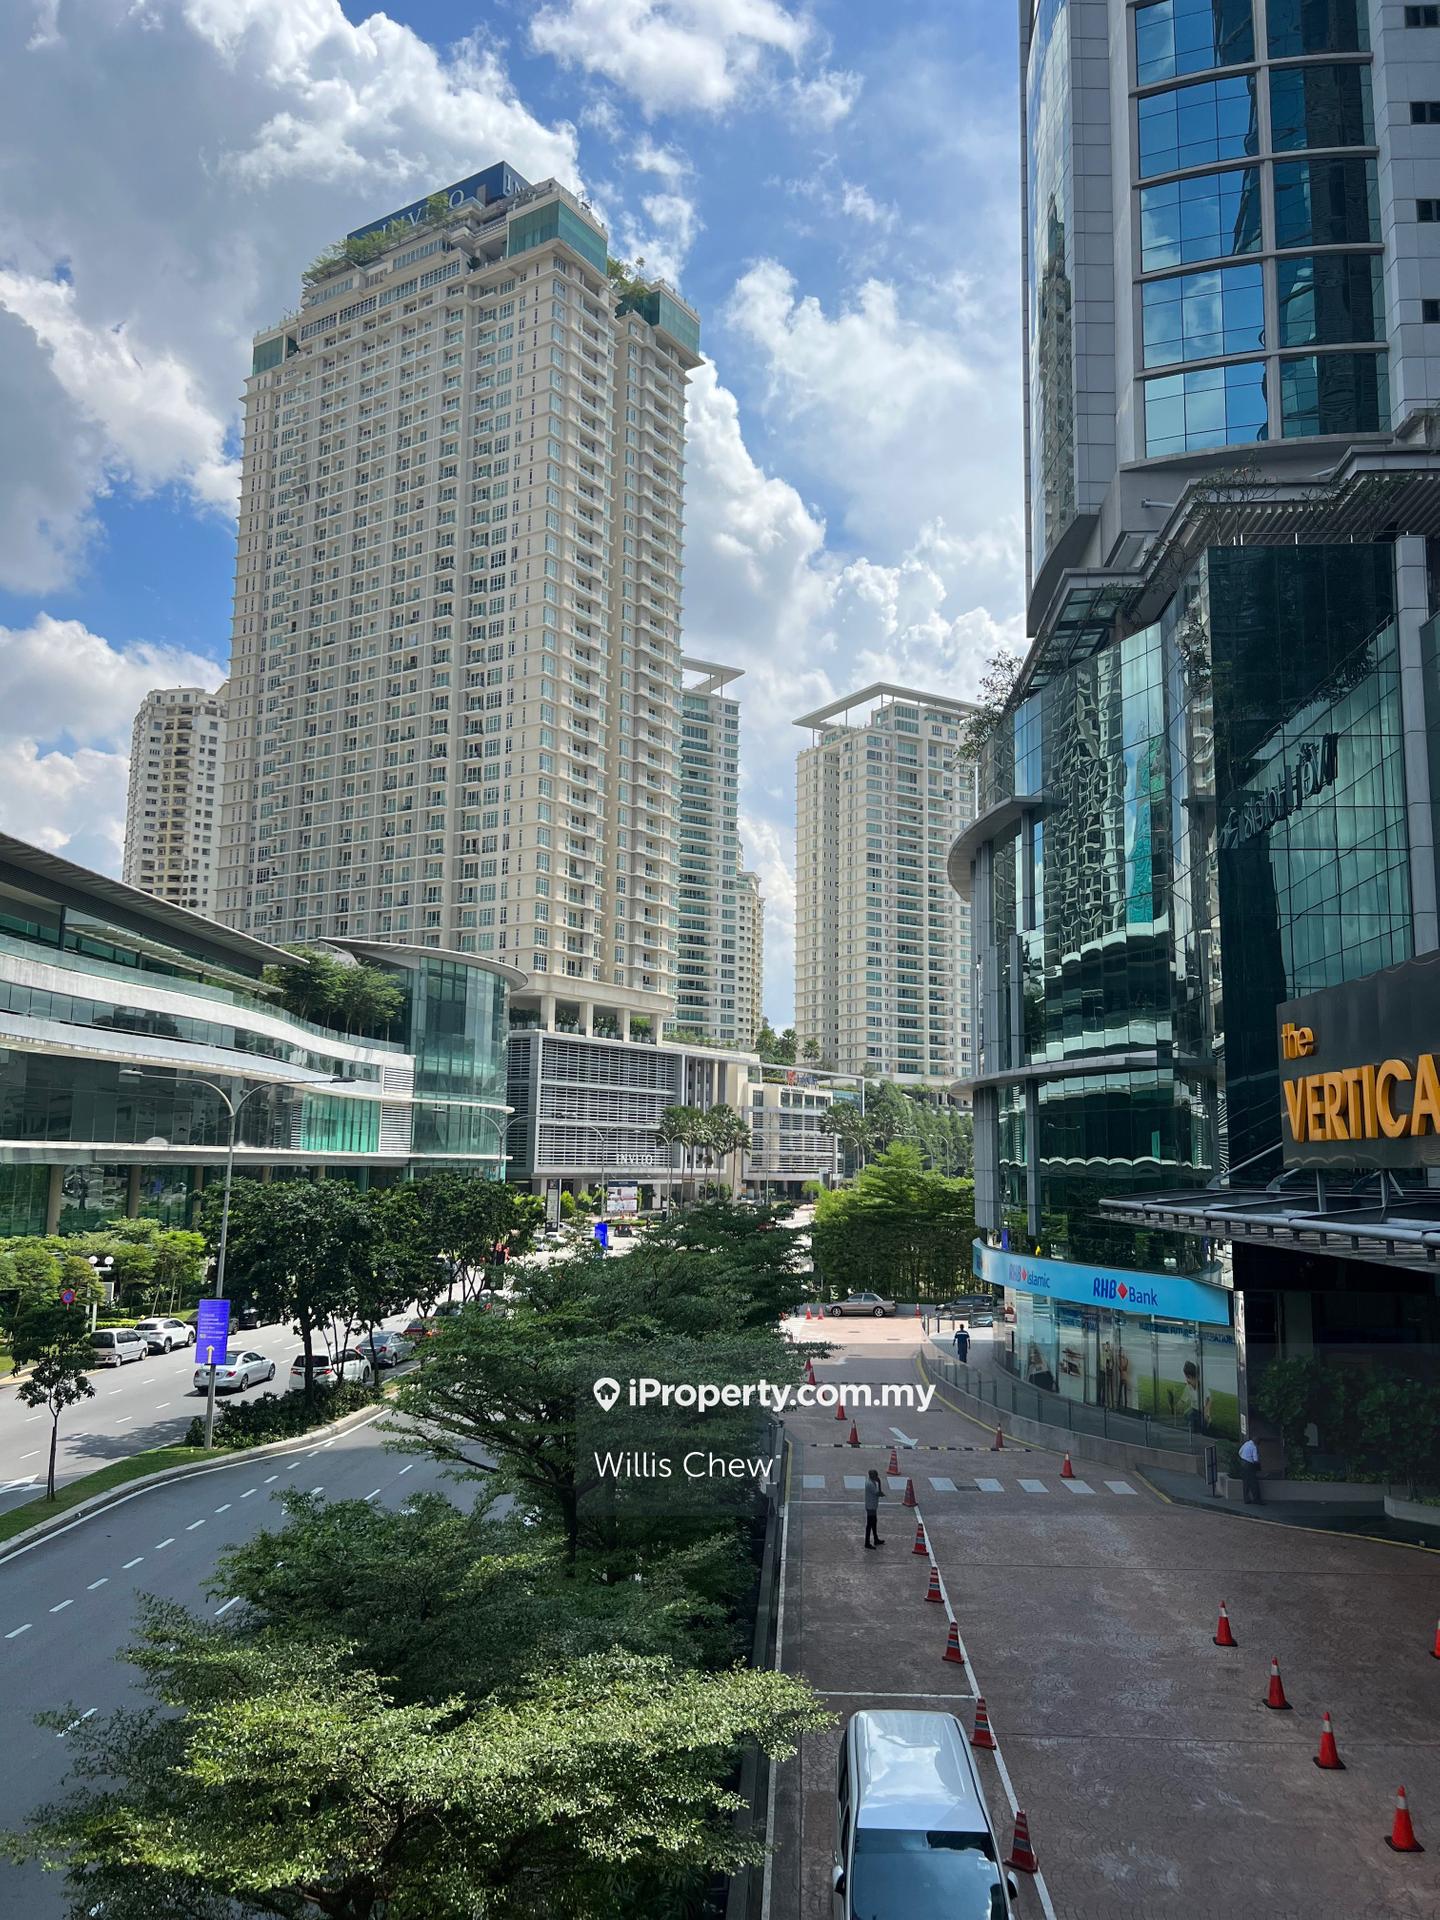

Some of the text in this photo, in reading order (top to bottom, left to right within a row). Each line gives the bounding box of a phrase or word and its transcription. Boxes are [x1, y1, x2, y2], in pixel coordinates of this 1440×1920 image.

[382, 189, 465, 237] IVIO
[1281, 1023, 1315, 1060] the
[616, 1153, 653, 1166] INVITO
[1009, 1263, 1051, 1289] RHB Islamic
[1093, 1277, 1158, 1306] RHB Bank
